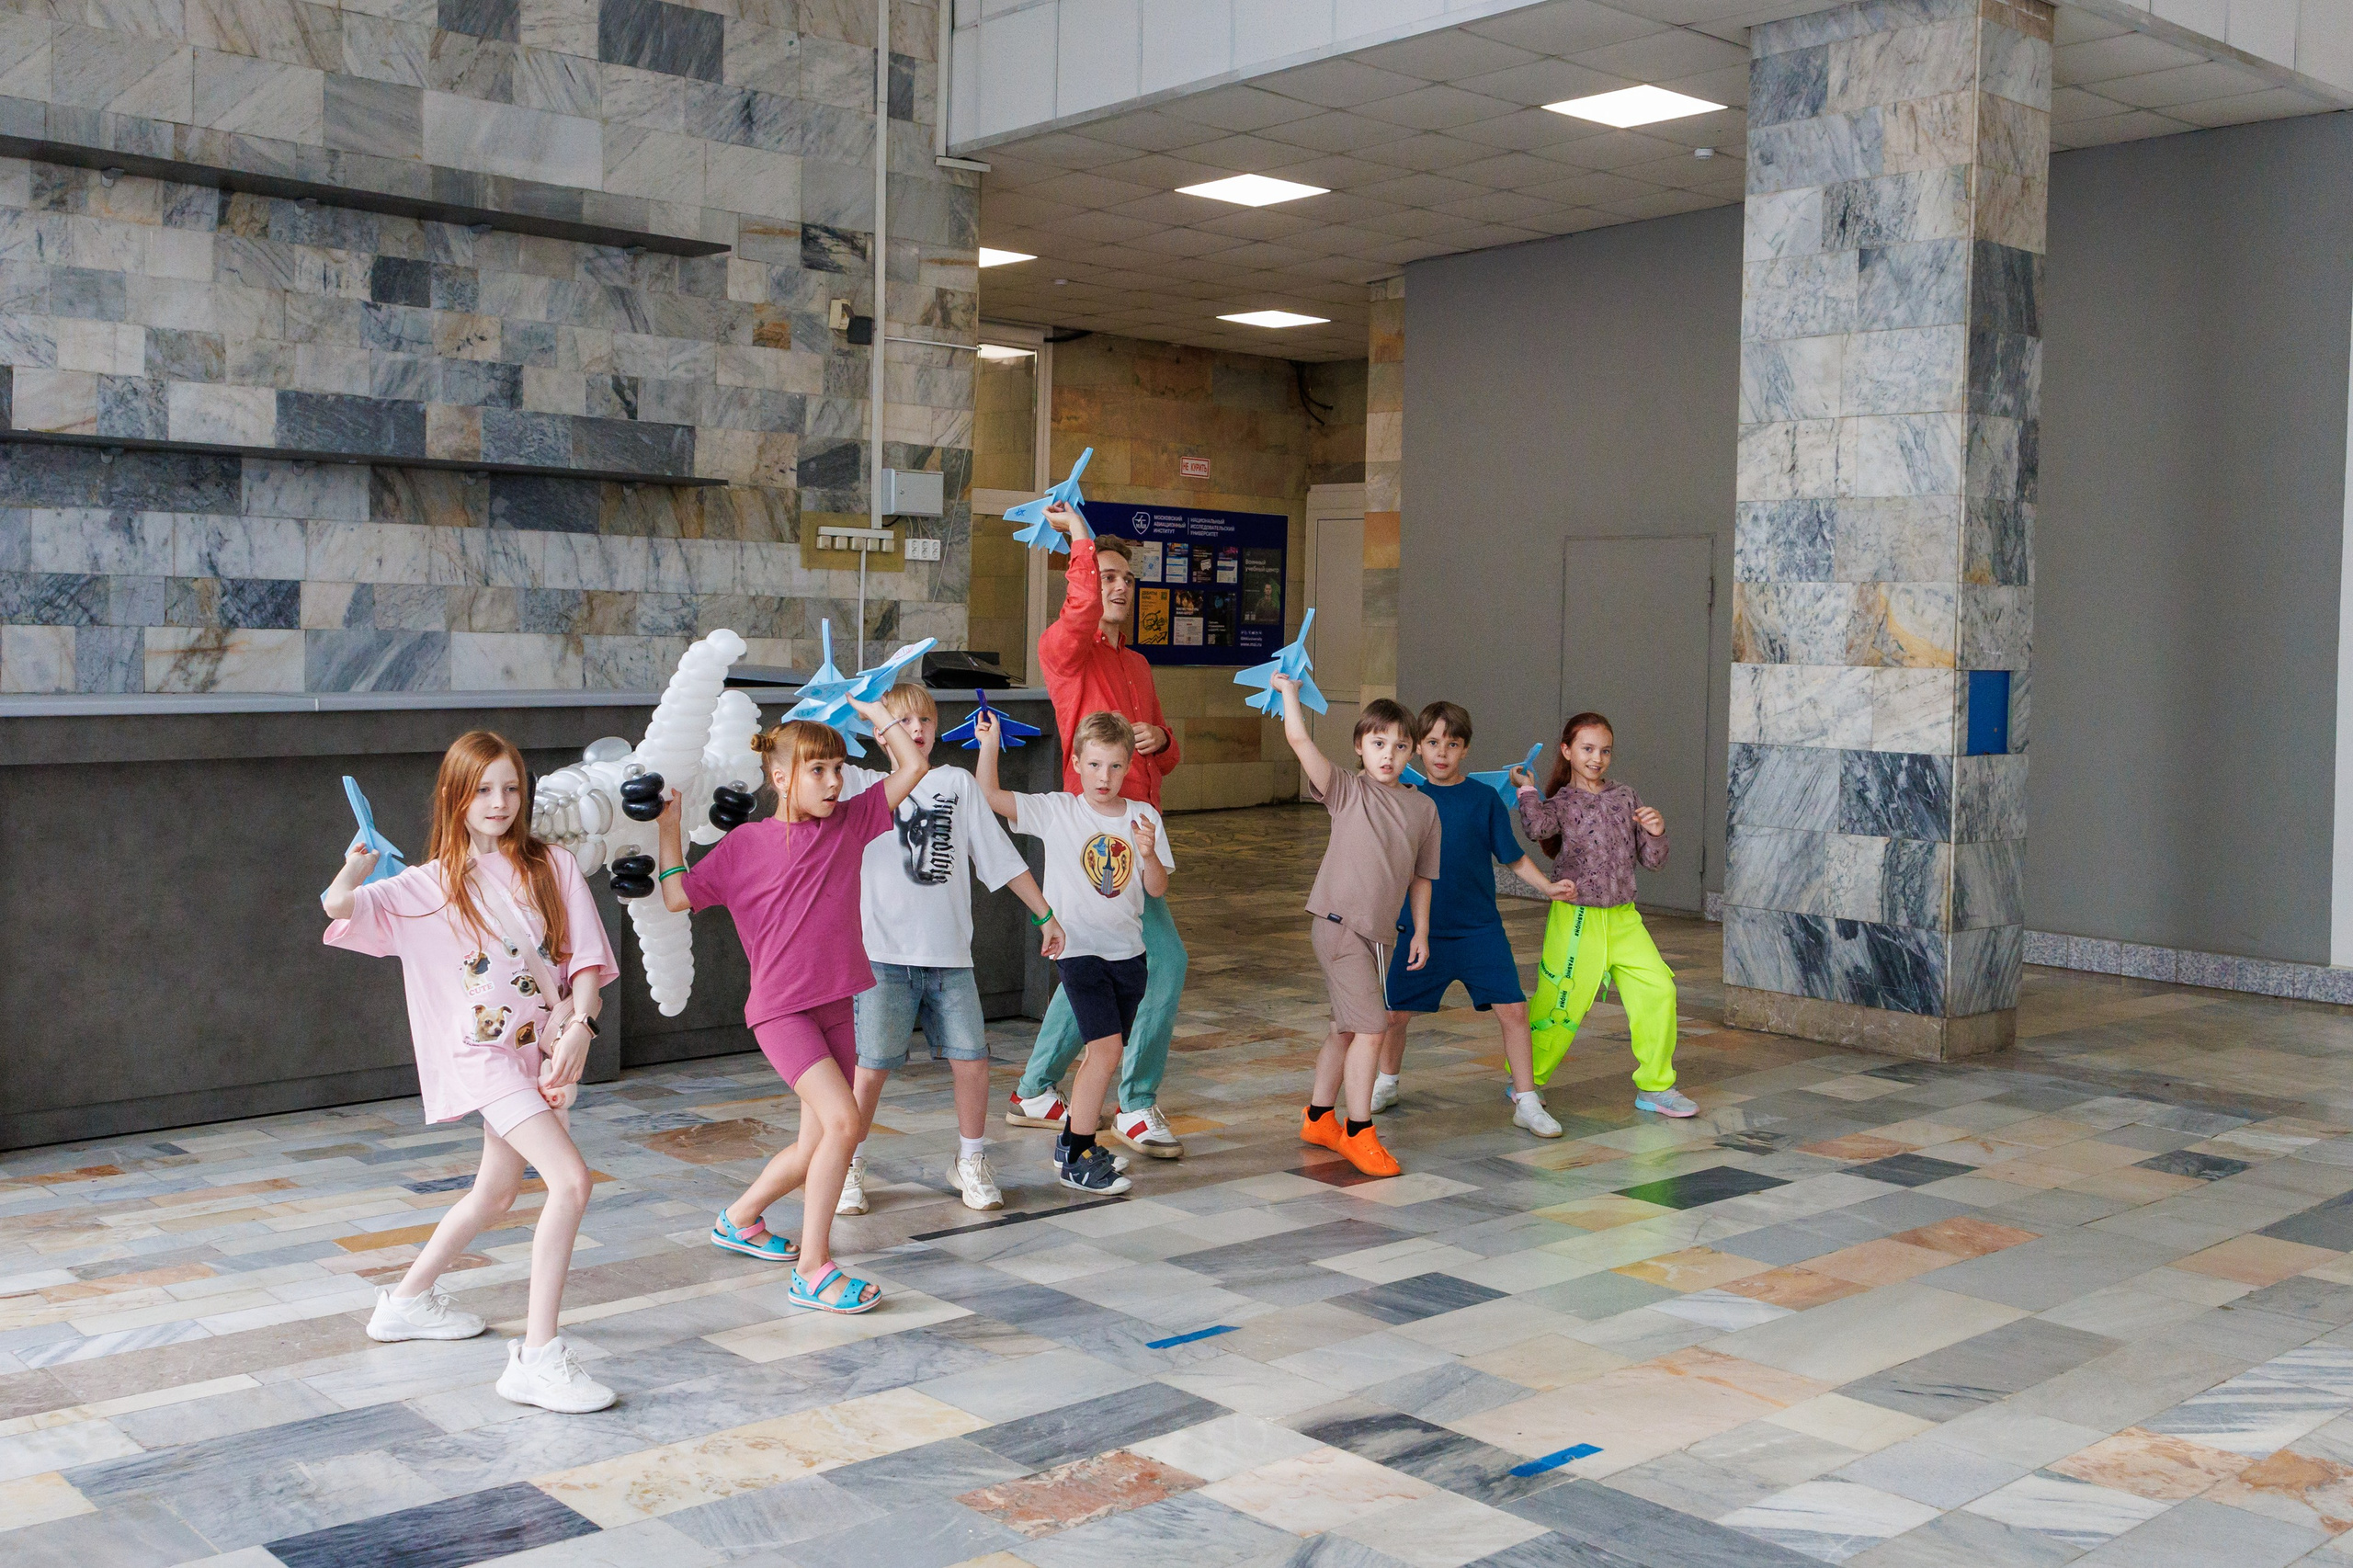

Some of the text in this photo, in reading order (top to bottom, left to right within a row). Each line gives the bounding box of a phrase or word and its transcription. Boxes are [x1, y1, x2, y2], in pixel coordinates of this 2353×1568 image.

[1182, 461, 1208, 473] НЕ КУРИТЬ
[1189, 524, 1235, 532] ИССЛЕДОВАТЕЛЬСКИЙ
[930, 791, 959, 883] Incredible
[469, 983, 494, 996] CUTE
